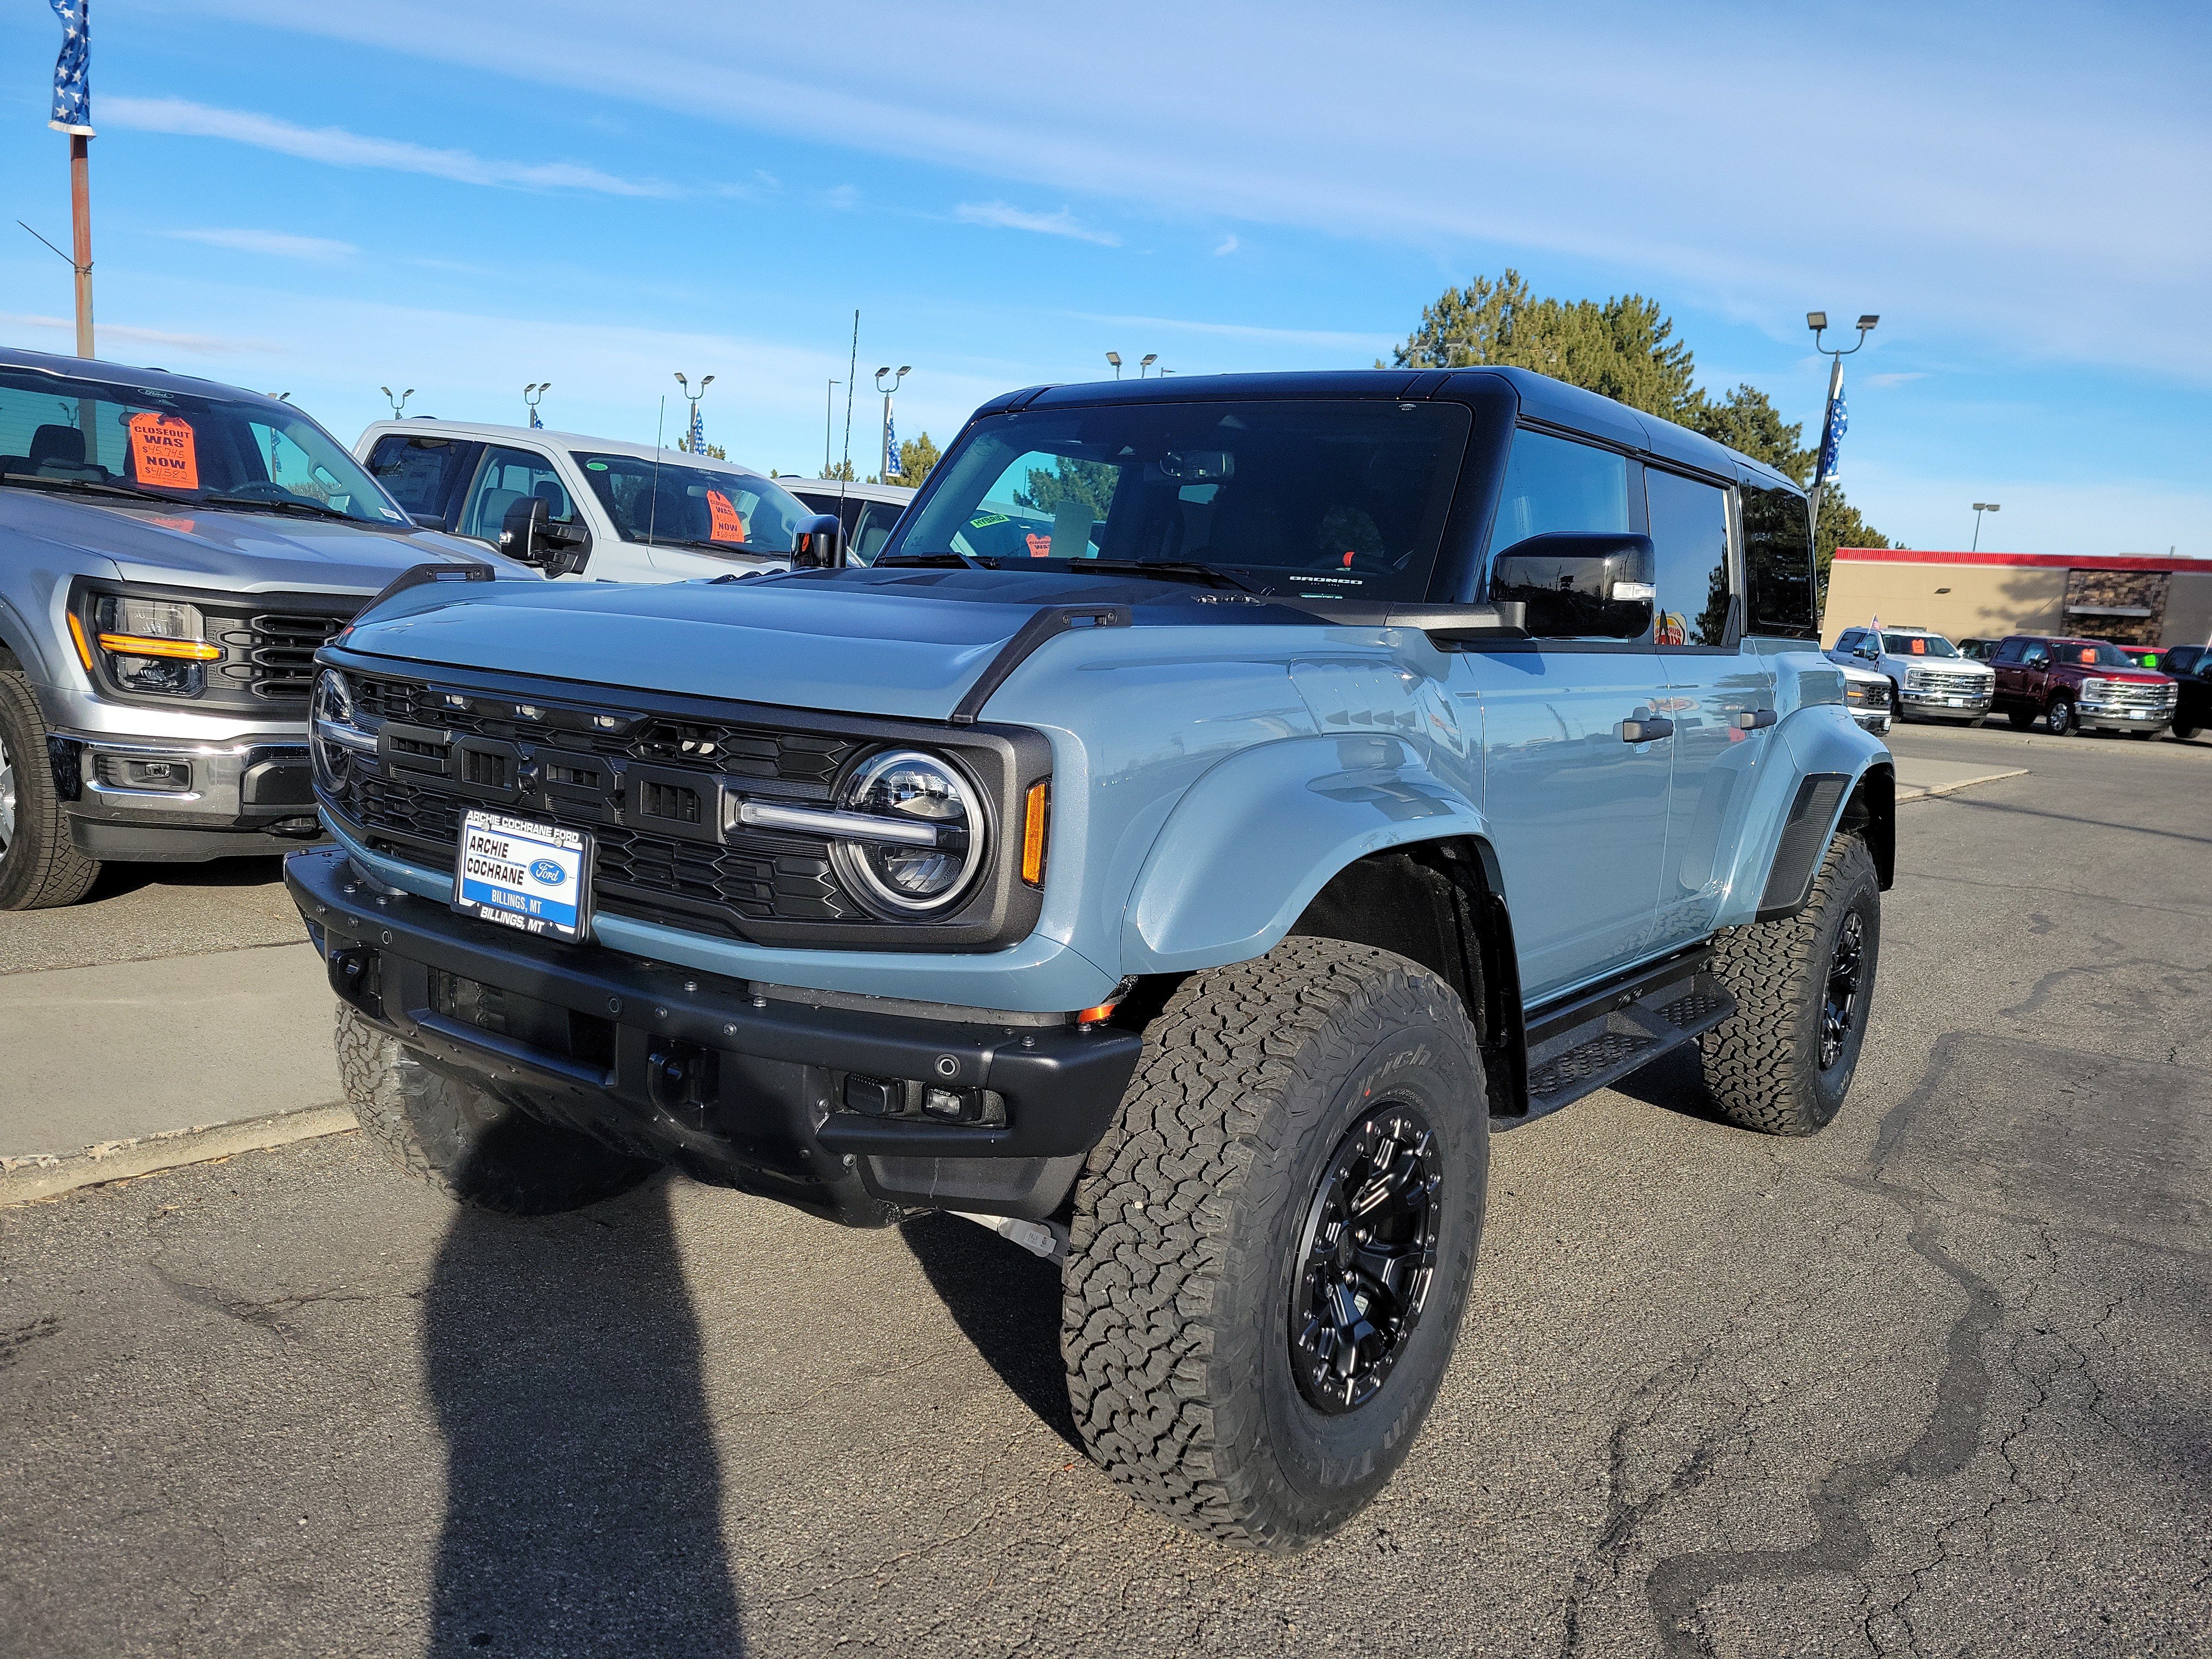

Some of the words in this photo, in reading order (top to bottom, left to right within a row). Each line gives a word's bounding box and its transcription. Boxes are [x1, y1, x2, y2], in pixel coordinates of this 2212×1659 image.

[134, 426, 190, 438] CLOSEOUT
[143, 435, 184, 447] WAS
[146, 456, 185, 469] NOW
[715, 506, 733, 516] WAS
[719, 522, 737, 532] NOW
[973, 515, 1005, 526] HYBRID
[1289, 576, 1363, 585] BRONCO
[379, 721, 725, 845] FORD
[466, 810, 500, 825] ARCHIE
[501, 818, 552, 837] COCHRANE
[554, 828, 579, 842] FORD
[469, 836, 509, 859] ARCHIE
[467, 857, 524, 885] COCHRANE
[535, 862, 560, 882] Ford
[492, 889, 528, 913] BILLINGS,
[529, 899, 542, 914] MT
[480, 907, 525, 930] BILLINGS,
[527, 919, 545, 933] MT
